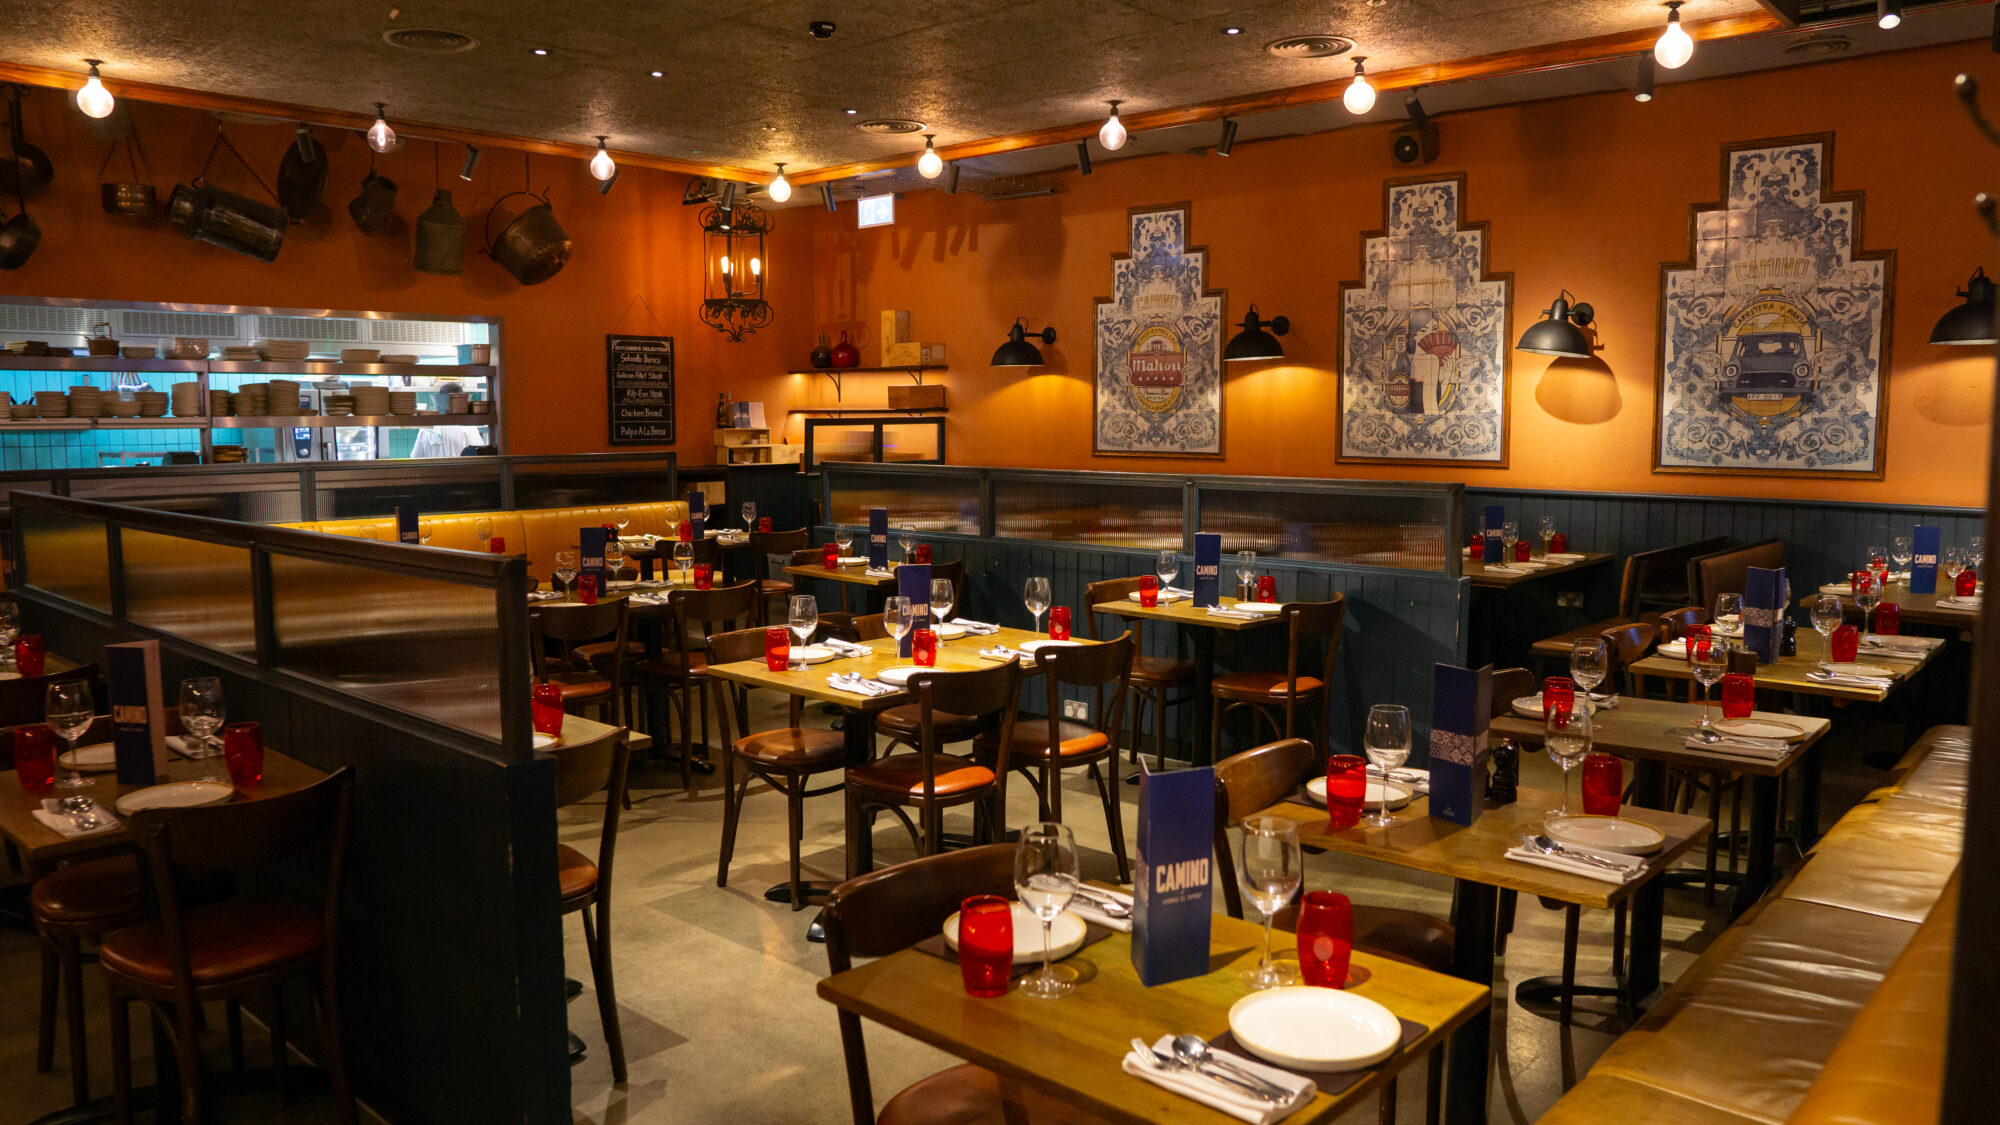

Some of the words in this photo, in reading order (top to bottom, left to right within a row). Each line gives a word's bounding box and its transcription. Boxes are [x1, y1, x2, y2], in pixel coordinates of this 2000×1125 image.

[1735, 258, 1809, 281] CAMINO
[1733, 303, 1774, 328] CARRETERA
[1779, 304, 1785, 313] Y
[648, 372, 663, 380] Steak
[626, 389, 649, 398] Rib-Eye
[649, 389, 663, 398] Steak
[621, 408, 645, 417] Chicken
[645, 407, 663, 417] Breast
[621, 427, 638, 438] Pulpo
[643, 426, 651, 436] La
[1914, 554, 1936, 564] CAMINO
[1196, 565, 1218, 576] CAMINO
[1156, 857, 1209, 894] CAMINO
